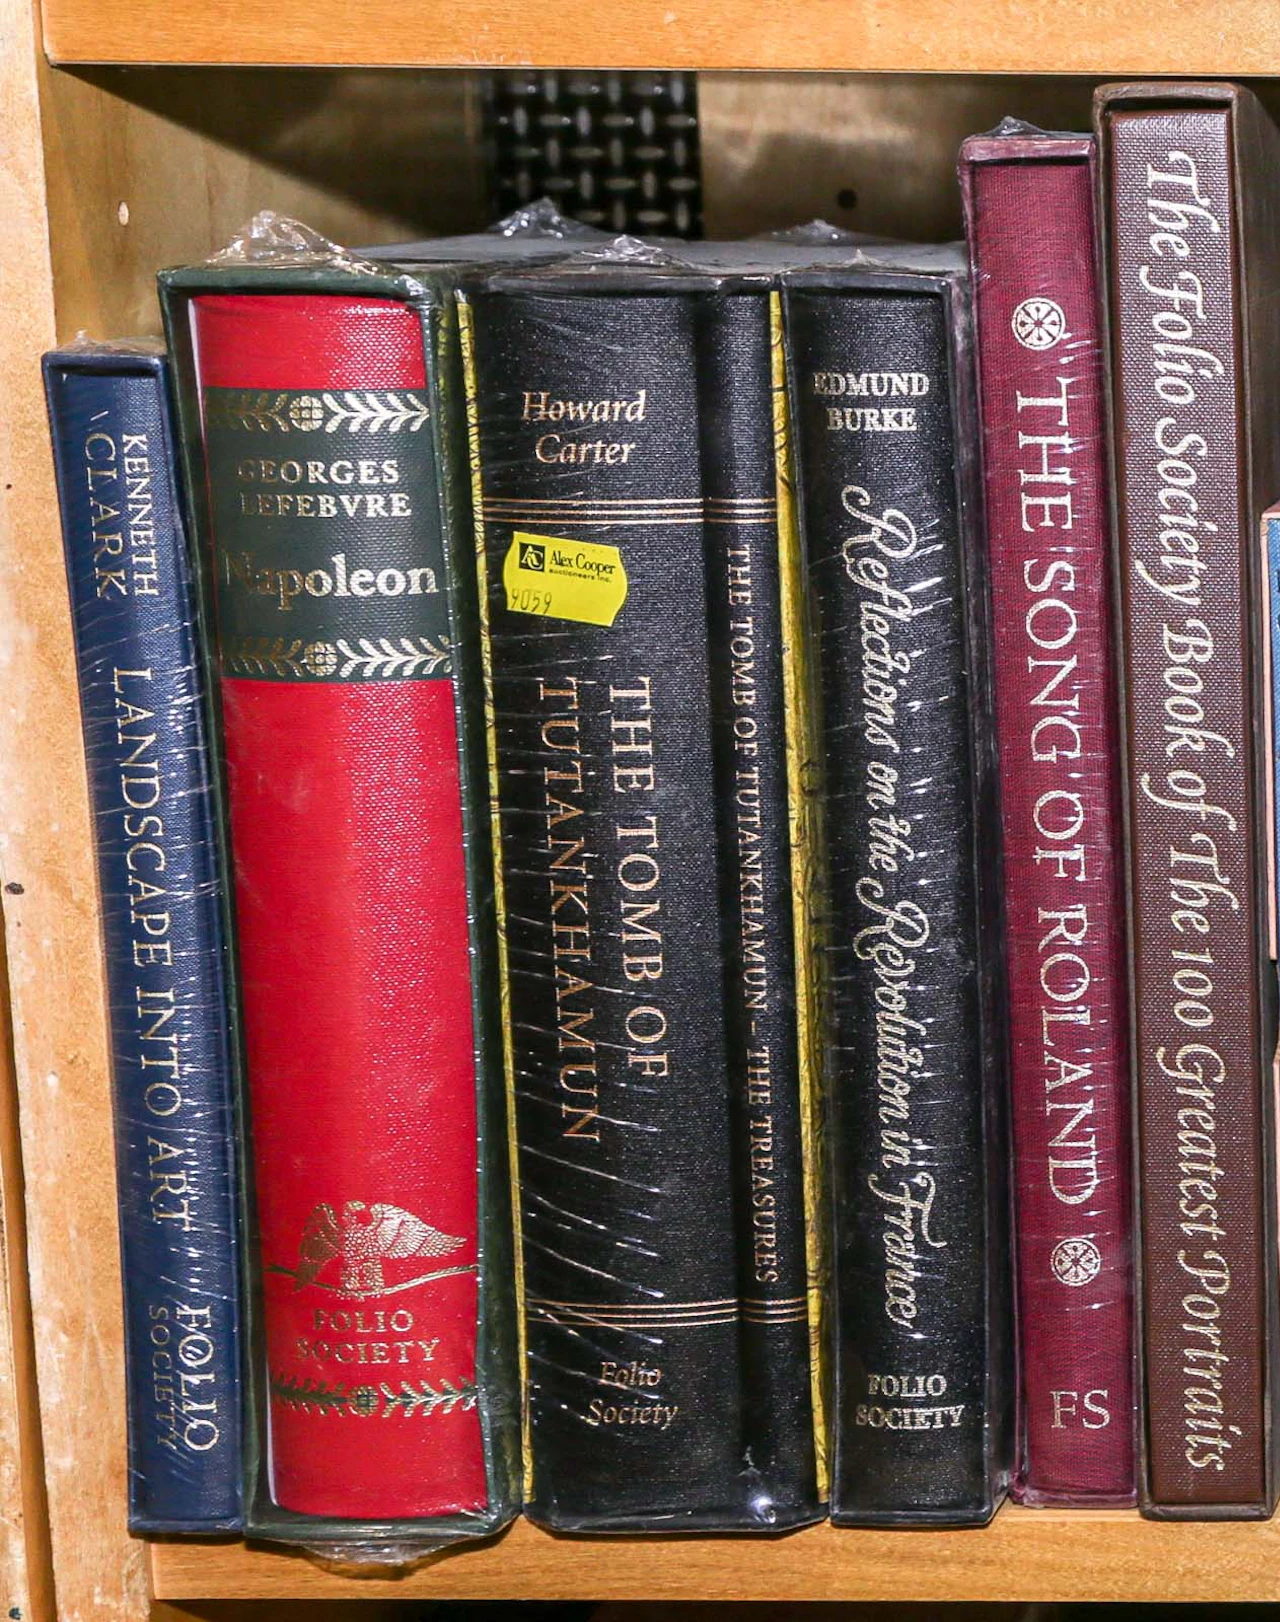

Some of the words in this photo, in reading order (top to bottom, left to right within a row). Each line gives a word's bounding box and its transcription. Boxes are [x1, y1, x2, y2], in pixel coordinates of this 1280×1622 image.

[1147, 150, 1220, 256] The
[1139, 265, 1224, 404] Folio
[521, 391, 646, 423] Howard
[813, 373, 929, 396] EDMUND
[827, 408, 917, 431] BURKE
[238, 460, 399, 484] GEORGES
[536, 435, 636, 465] Carter
[1016, 377, 1074, 532] THE
[85, 433, 119, 600] CLARK
[123, 434, 159, 596] KENNETH
[240, 494, 411, 518] LEFEBVRE
[1136, 417, 1217, 605] Society
[225, 552, 439, 611] Napoleon
[511, 588, 552, 614] 9059
[550, 550, 573, 568] Alex
[576, 553, 616, 576] Cooper
[727, 544, 750, 609] THE
[729, 620, 754, 705] TOMB
[842, 485, 917, 752] Reflections
[1024, 558, 1080, 762] SONG
[1165, 619, 1235, 757] Book
[609, 676, 654, 792] THE
[734, 714, 757, 757] OF
[112, 667, 170, 966] LANDSCAPE
[866, 761, 900, 811] on
[1141, 771, 1237, 831] of
[868, 813, 916, 872] the
[1033, 790, 1086, 881] OF
[539, 677, 599, 1141] TUTANKHAMUN
[615, 815, 663, 983] TOMB
[737, 765, 768, 1020] TUTANKHAMUN
[1170, 834, 1239, 934] The
[853, 877, 929, 1124] Revolution
[1172, 948, 1213, 1027] 100
[135, 988, 181, 1117] INTO
[625, 1005, 670, 1077] OF
[744, 1046, 771, 1108] THE
[1038, 905, 1100, 1203] ROLAND
[148, 1136, 190, 1233] ART
[880, 1129, 919, 1169] in
[1157, 1043, 1225, 1240] Greatest
[749, 1116, 779, 1284] TREASURES
[868, 1172, 947, 1328] France
[296, 1338, 439, 1362] SOCIETY
[312, 1310, 415, 1332] FOLIO
[1178, 1250, 1242, 1471] Portraits
[149, 1306, 178, 1448] SOCIETY
[176, 1305, 218, 1451] FOLIO
[584, 1401, 679, 1431] Society
[600, 1361, 661, 1389] Folio
[856, 1405, 964, 1429] SOCIETY
[868, 1374, 947, 1397] FOLIO
[1050, 1390, 1110, 1429] FS
